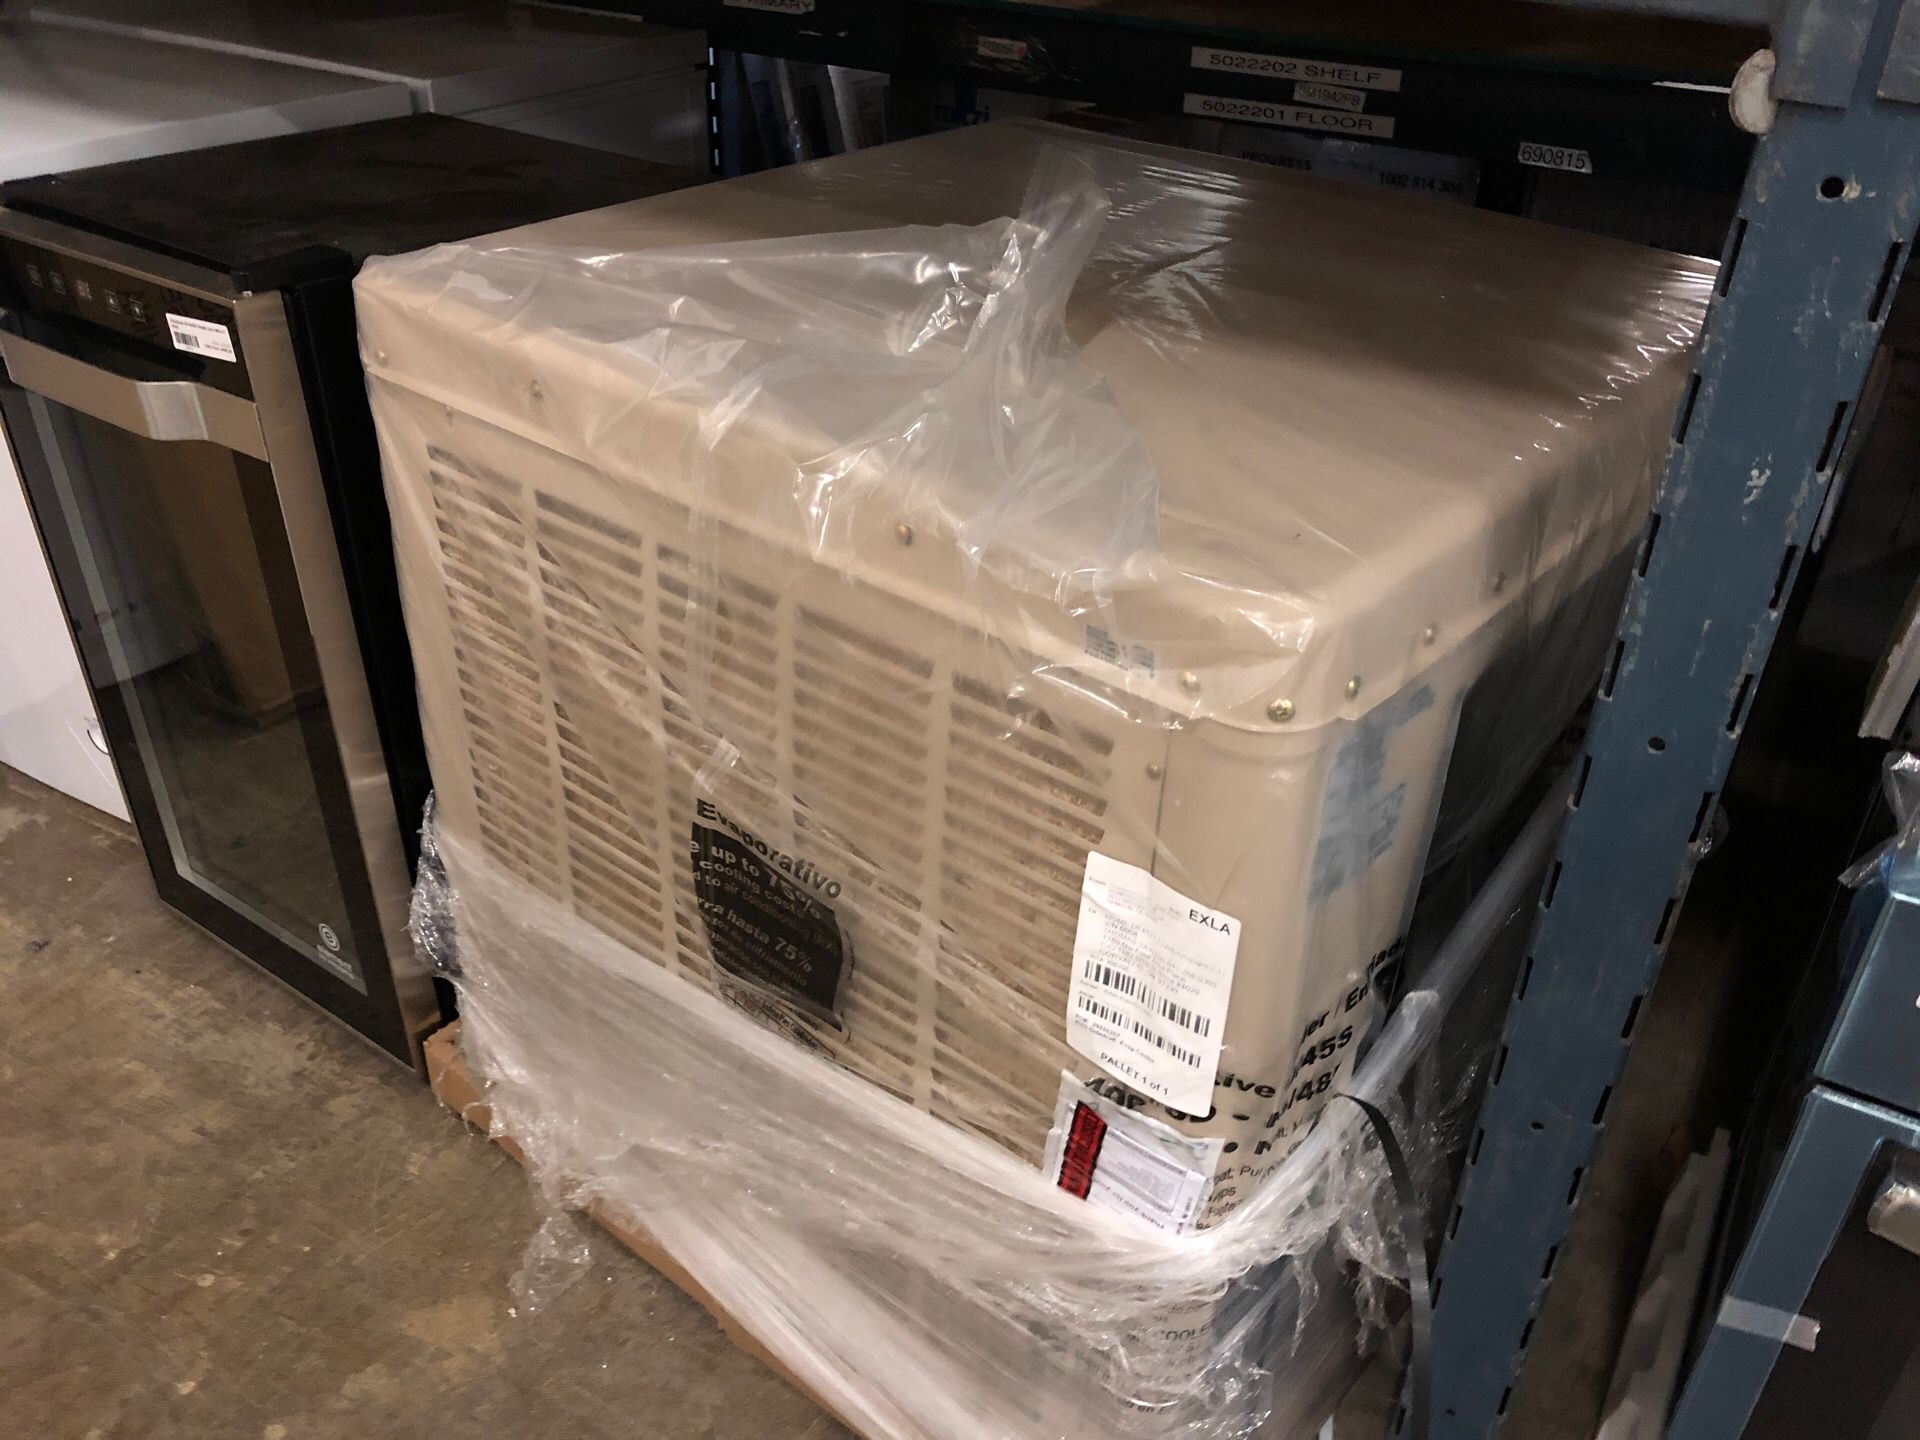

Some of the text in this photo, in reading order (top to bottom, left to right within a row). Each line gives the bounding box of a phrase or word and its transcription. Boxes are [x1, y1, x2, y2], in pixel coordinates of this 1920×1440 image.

[1210, 53, 1382, 84] 5022202 SHELF
[1202, 100, 1373, 132] 5022201 FLOOR
[1522, 145, 1585, 169] 690815
[697, 798, 841, 899] Evaporativo
[711, 845, 737, 865] up
[741, 857, 760, 877] to
[699, 860, 760, 895] cooling
[705, 874, 721, 887] to
[1189, 908, 1231, 936] EXLA
[726, 909, 770, 945] hasta
[775, 936, 813, 973] 75%
[1100, 1052, 1140, 1080] PALLET
[1150, 1079, 1162, 1092] of
